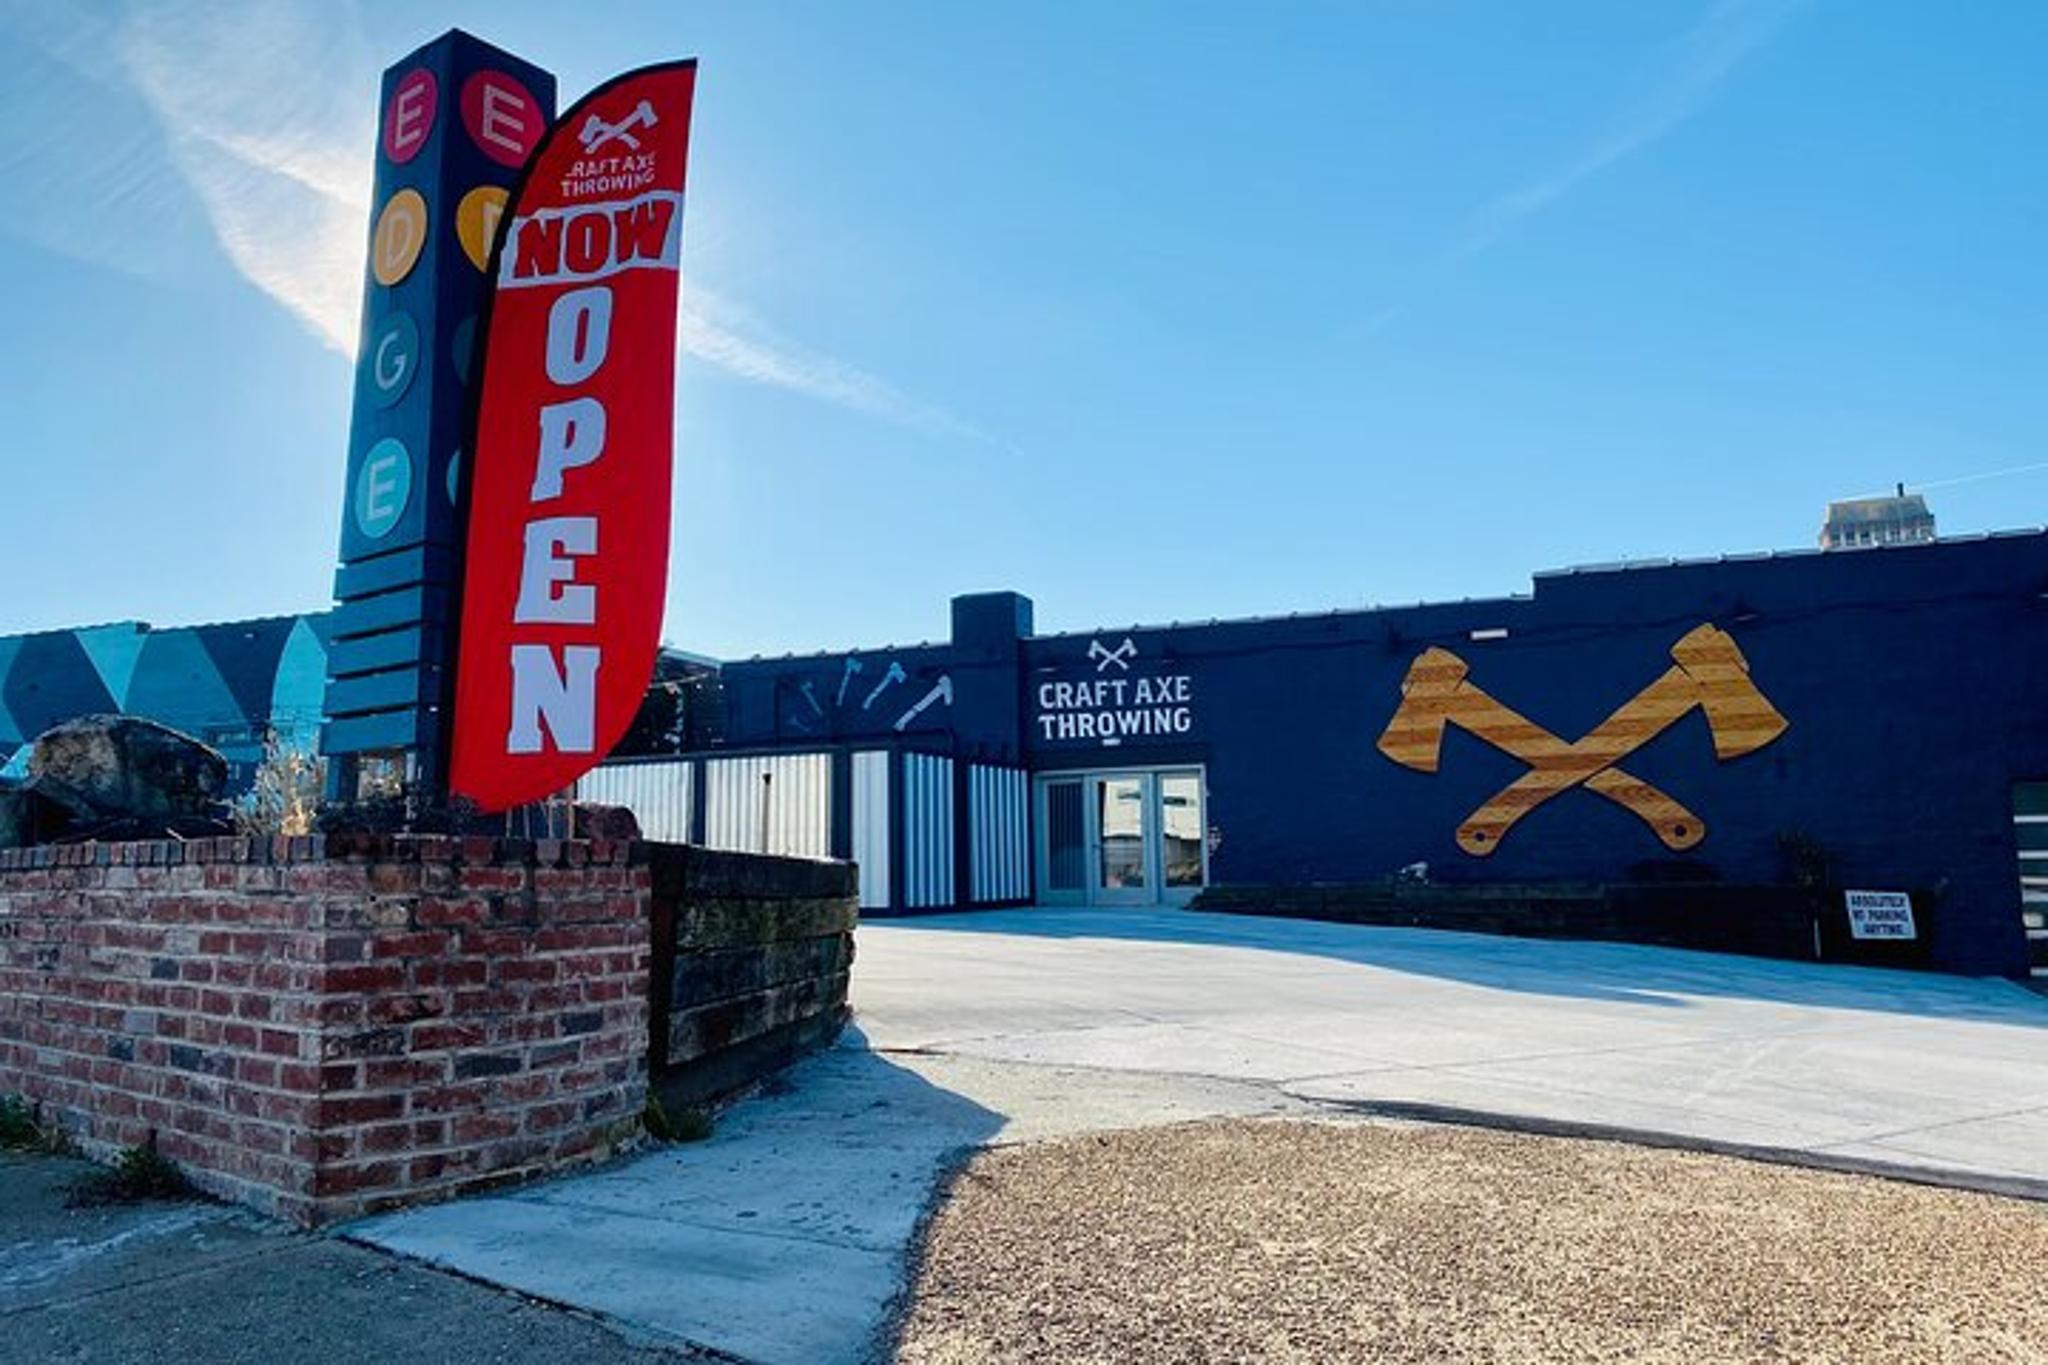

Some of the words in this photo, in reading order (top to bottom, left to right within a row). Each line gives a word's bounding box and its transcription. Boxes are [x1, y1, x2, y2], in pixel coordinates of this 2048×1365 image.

[561, 169, 656, 196] THROWING
[514, 200, 676, 279] NOW
[506, 286, 613, 753] OPEN
[1039, 680, 1127, 708] CRAFT
[1135, 676, 1191, 703] AXE
[1038, 708, 1191, 740] THROWING
